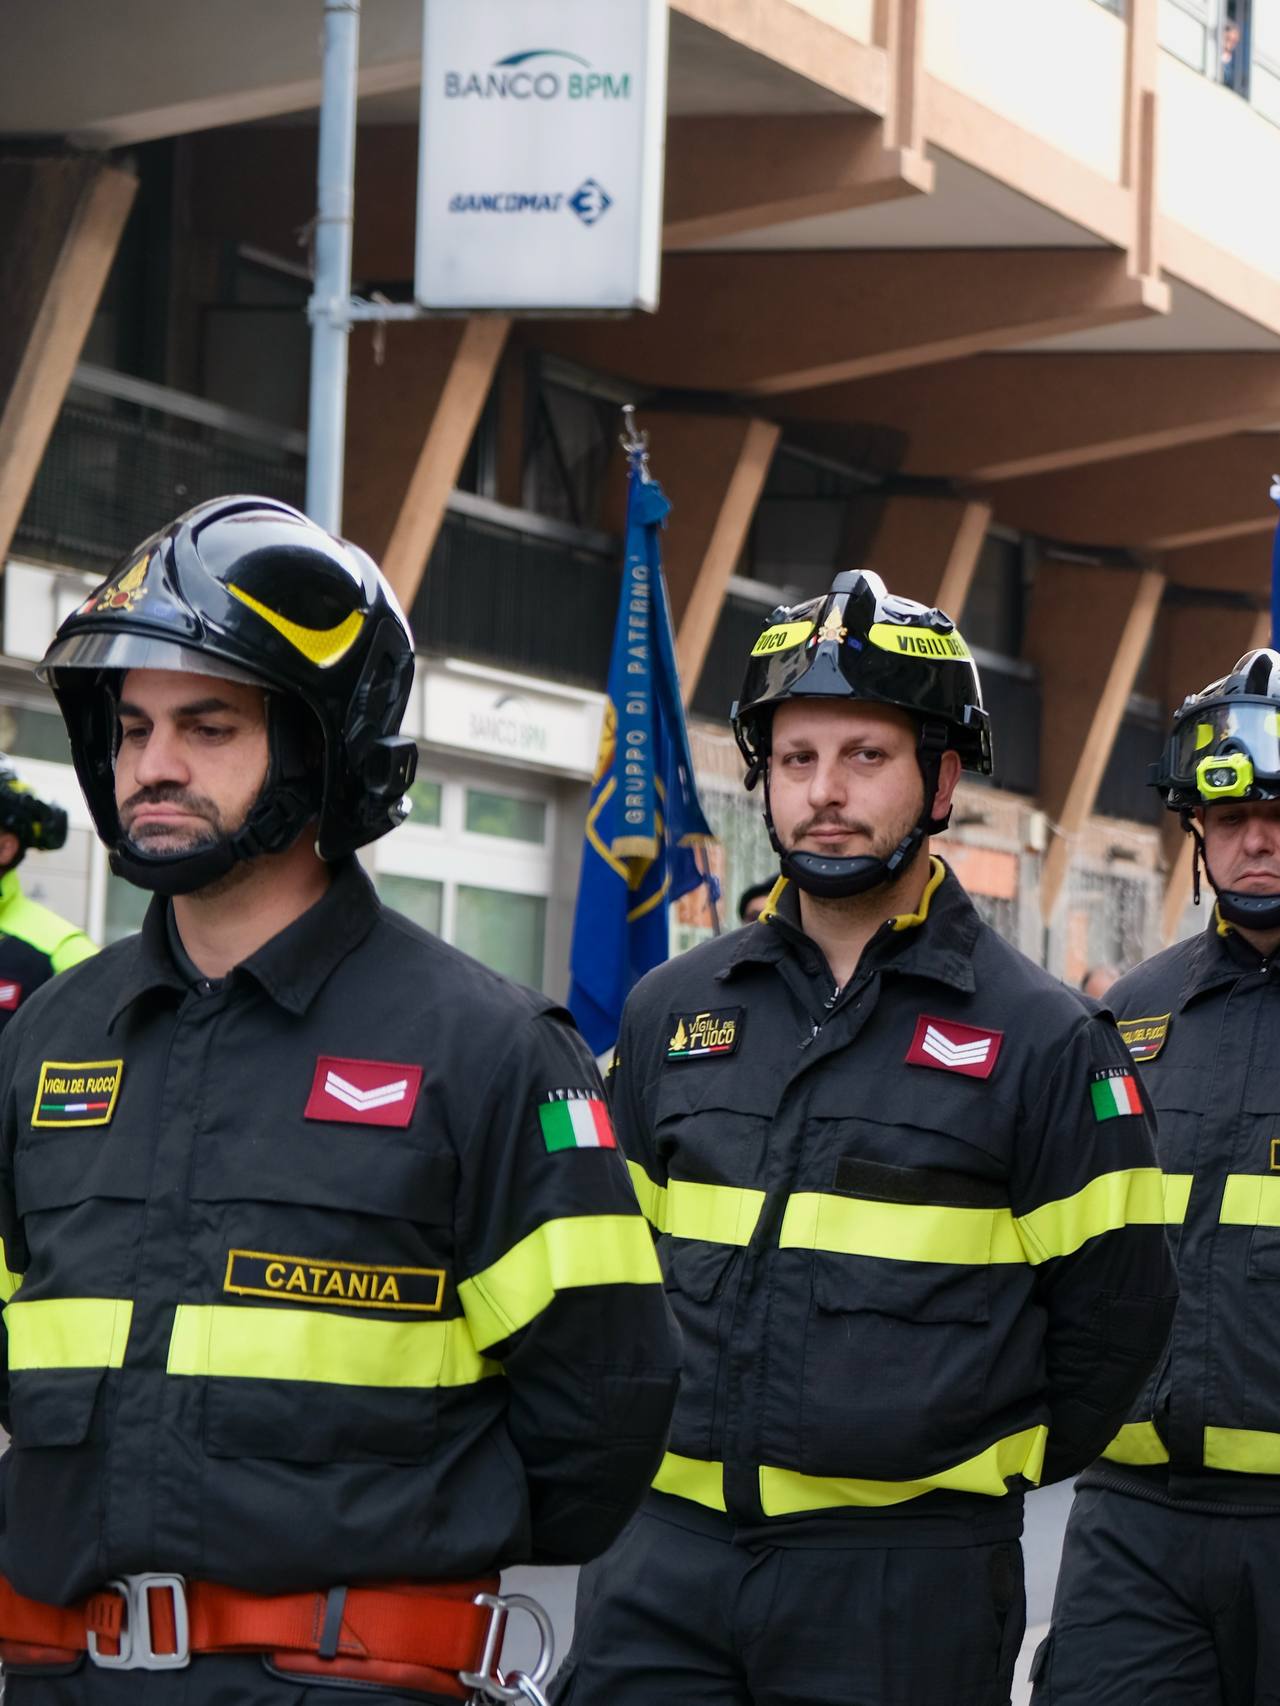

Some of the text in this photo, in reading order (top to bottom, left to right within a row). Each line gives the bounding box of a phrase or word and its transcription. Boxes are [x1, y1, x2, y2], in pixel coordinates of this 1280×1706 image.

[445, 72, 630, 99] BANCO BPM
[449, 192, 563, 213] BANCOMAT
[896, 635, 947, 655] VIGILI
[626, 690, 648, 715] DI
[625, 730, 648, 824] GRUPPO
[689, 1013, 719, 1034] VIGILI
[690, 1028, 736, 1049] FUOCO
[44, 1075, 116, 1094] VIGILI DEL FUOCO
[264, 1261, 401, 1302] CATANIA
